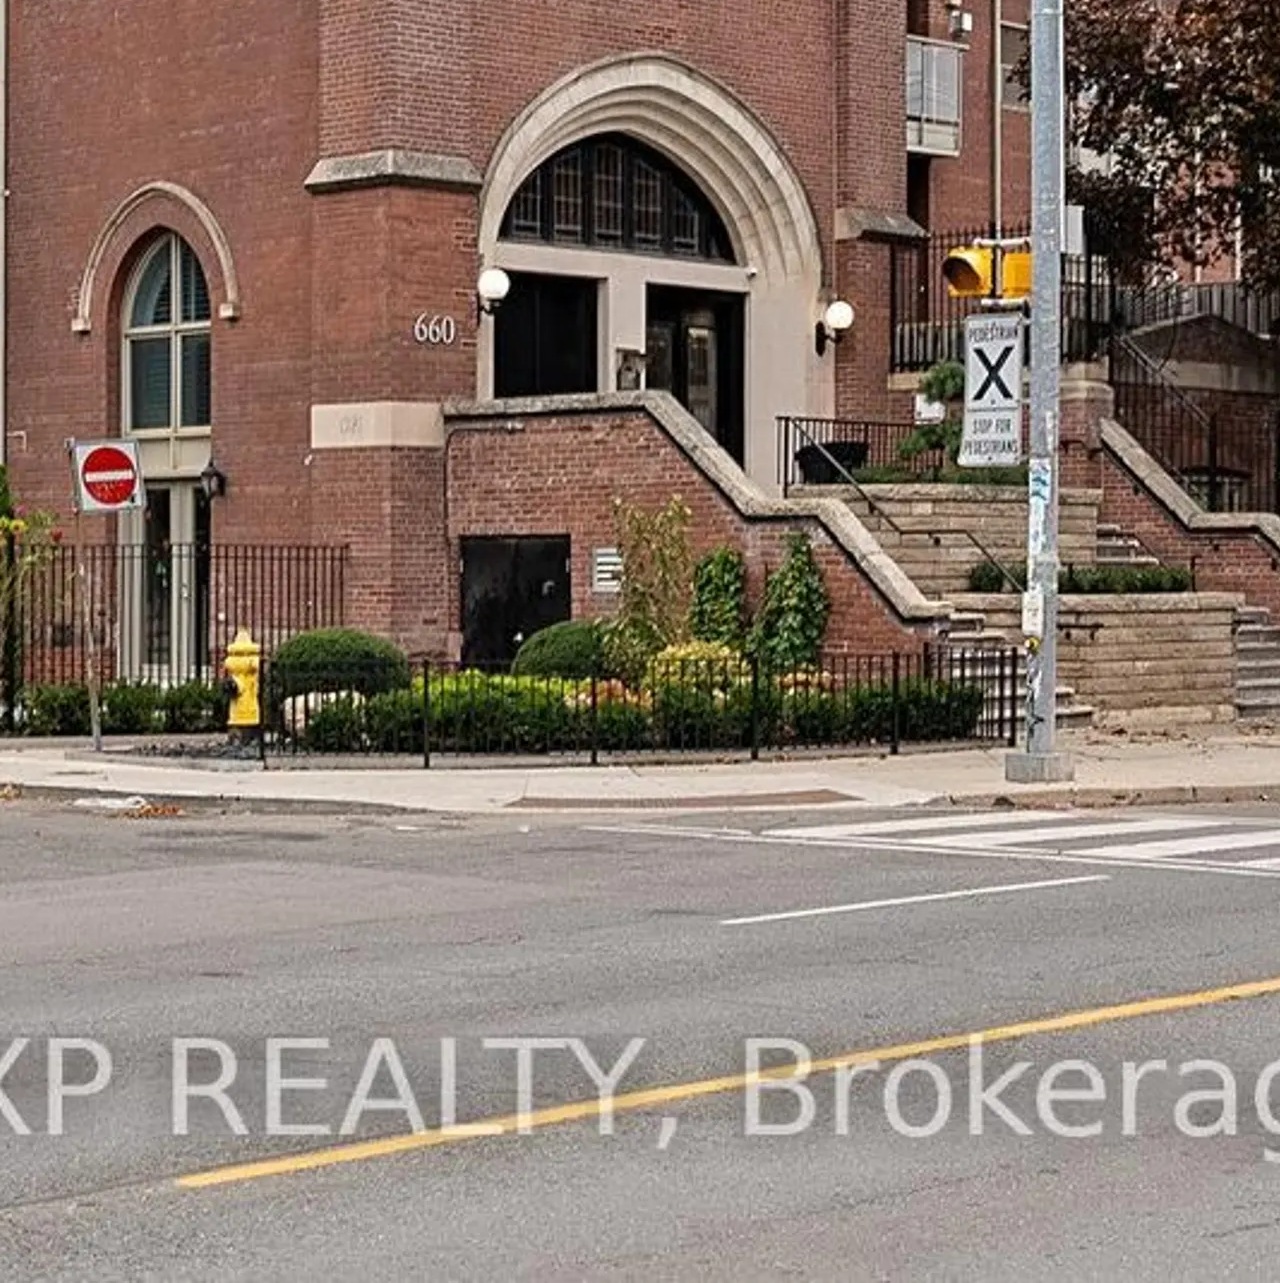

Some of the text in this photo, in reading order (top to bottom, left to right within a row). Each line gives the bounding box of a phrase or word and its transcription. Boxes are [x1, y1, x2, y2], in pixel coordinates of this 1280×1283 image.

[414, 312, 454, 343] 660
[968, 324, 1018, 343] PEDESTRIAN
[973, 418, 1011, 434] STOP FOR
[963, 438, 1018, 456] PEDESTRIANS
